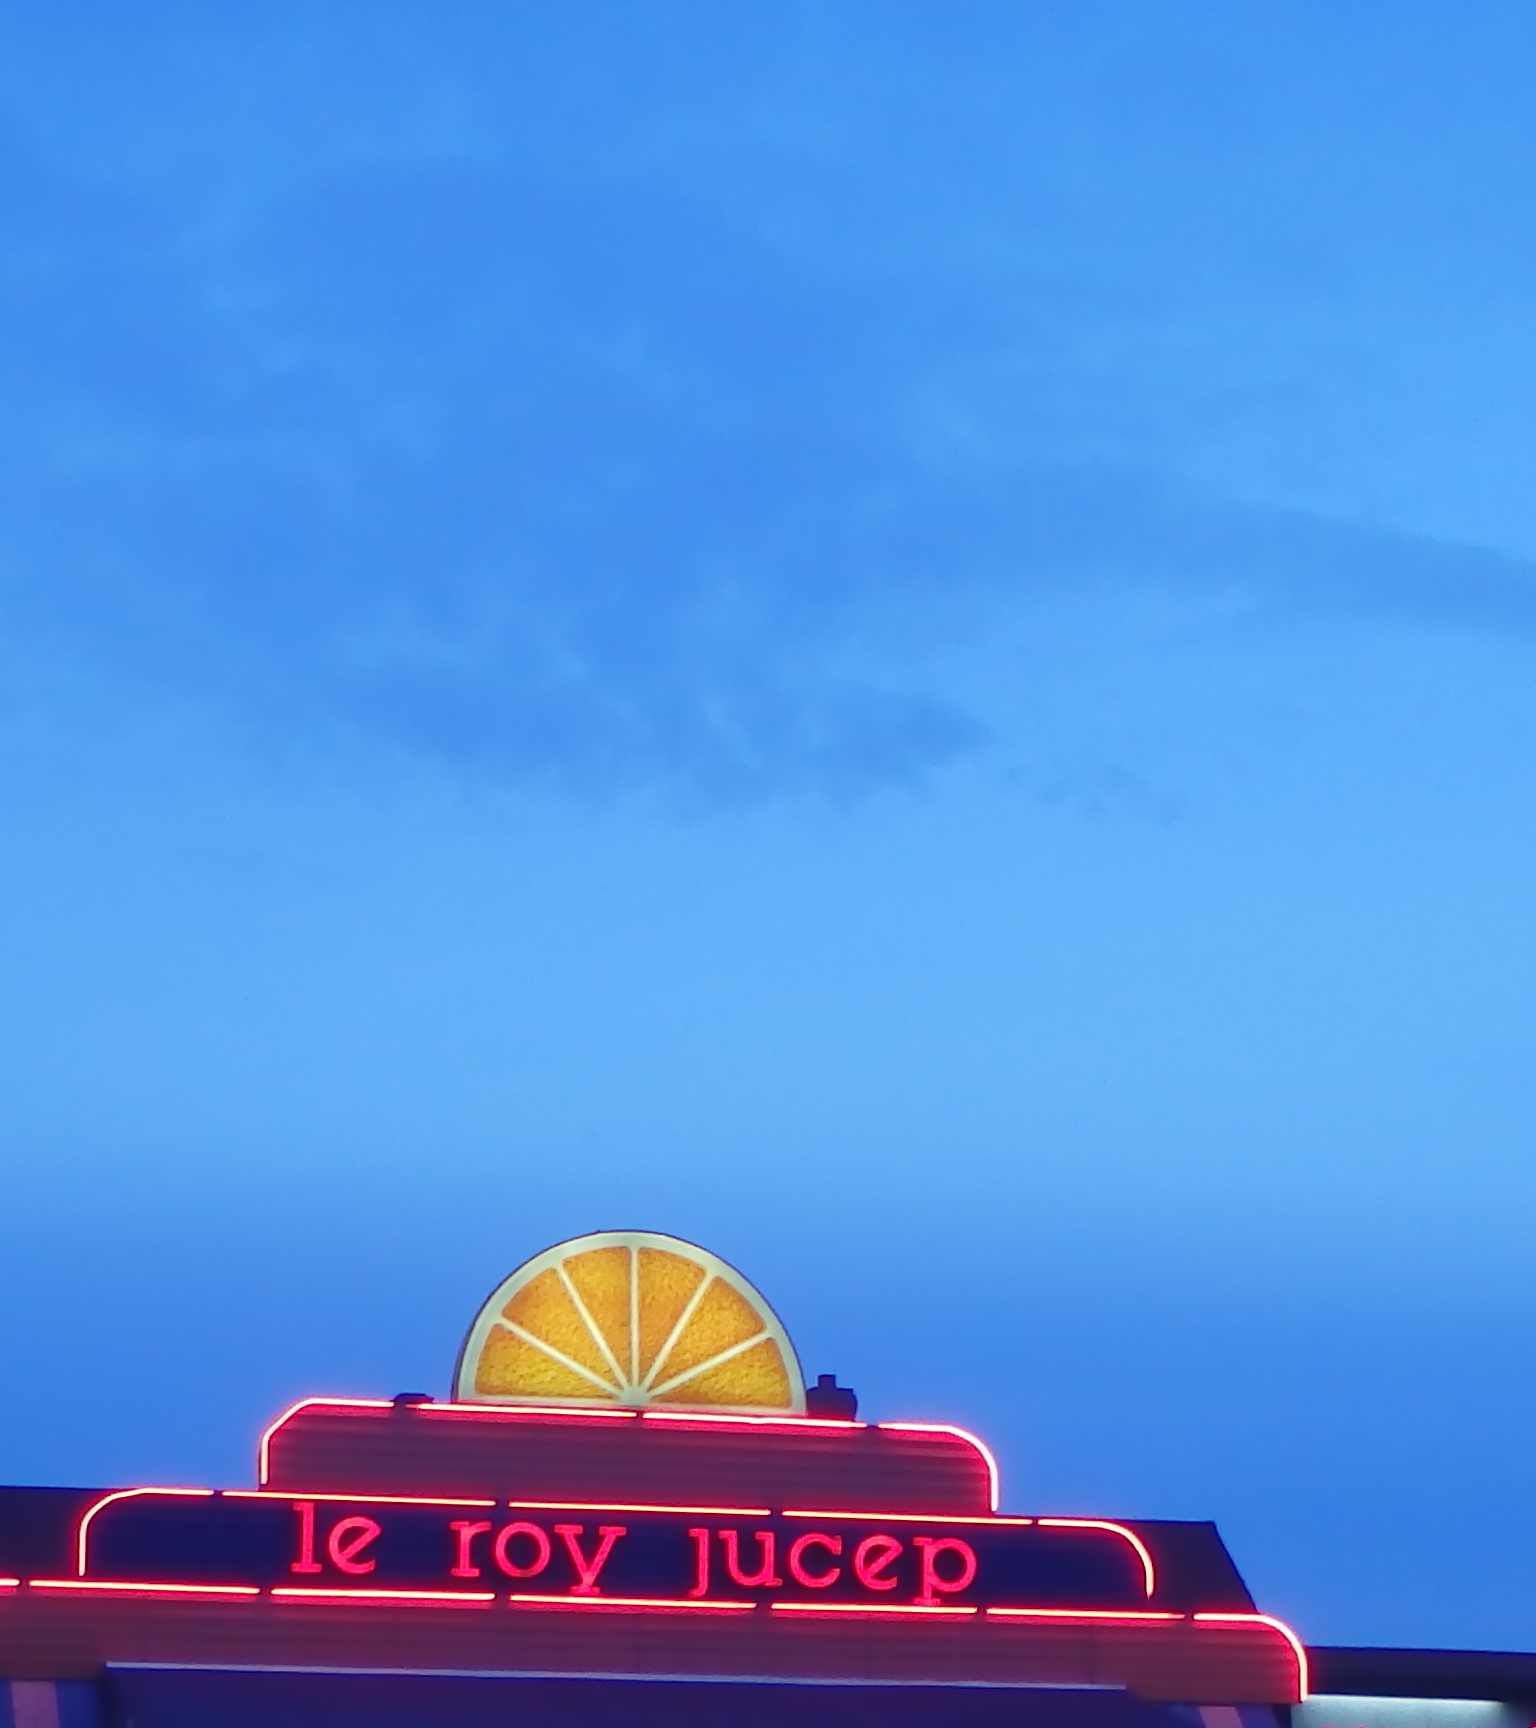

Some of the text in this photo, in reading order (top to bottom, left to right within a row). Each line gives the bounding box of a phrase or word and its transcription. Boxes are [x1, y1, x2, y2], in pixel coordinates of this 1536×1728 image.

[290, 1501, 978, 1606] le roy jucep
